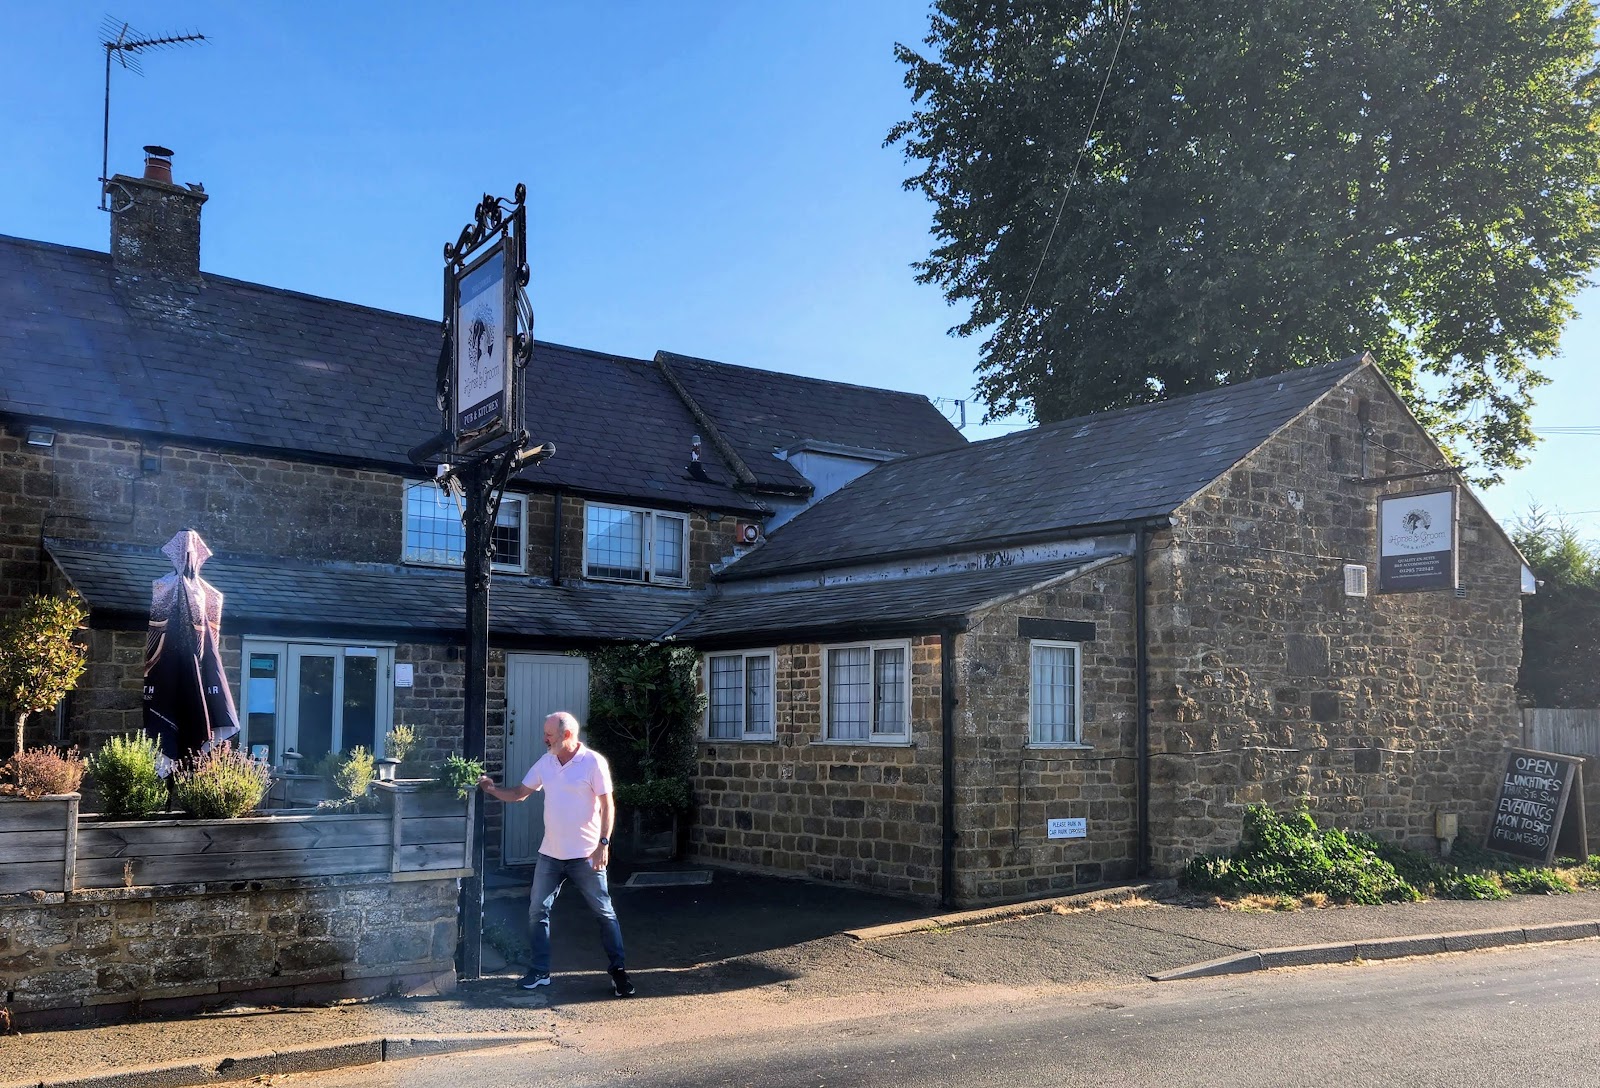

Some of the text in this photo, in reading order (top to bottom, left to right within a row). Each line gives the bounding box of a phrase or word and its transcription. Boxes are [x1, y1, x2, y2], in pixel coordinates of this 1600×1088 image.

[464, 412, 474, 425] PUB
[478, 398, 499, 418] KITCHEN
[1388, 534, 1412, 546] Horse
[1420, 531, 1446, 543] Groom
[1415, 540, 1435, 549] KITCHEN
[1516, 757, 1558, 776] OPEN
[1504, 773, 1562, 791] LUNCHTIMES
[1499, 798, 1554, 821] EVENINGS
[1496, 813, 1519, 828] MON
